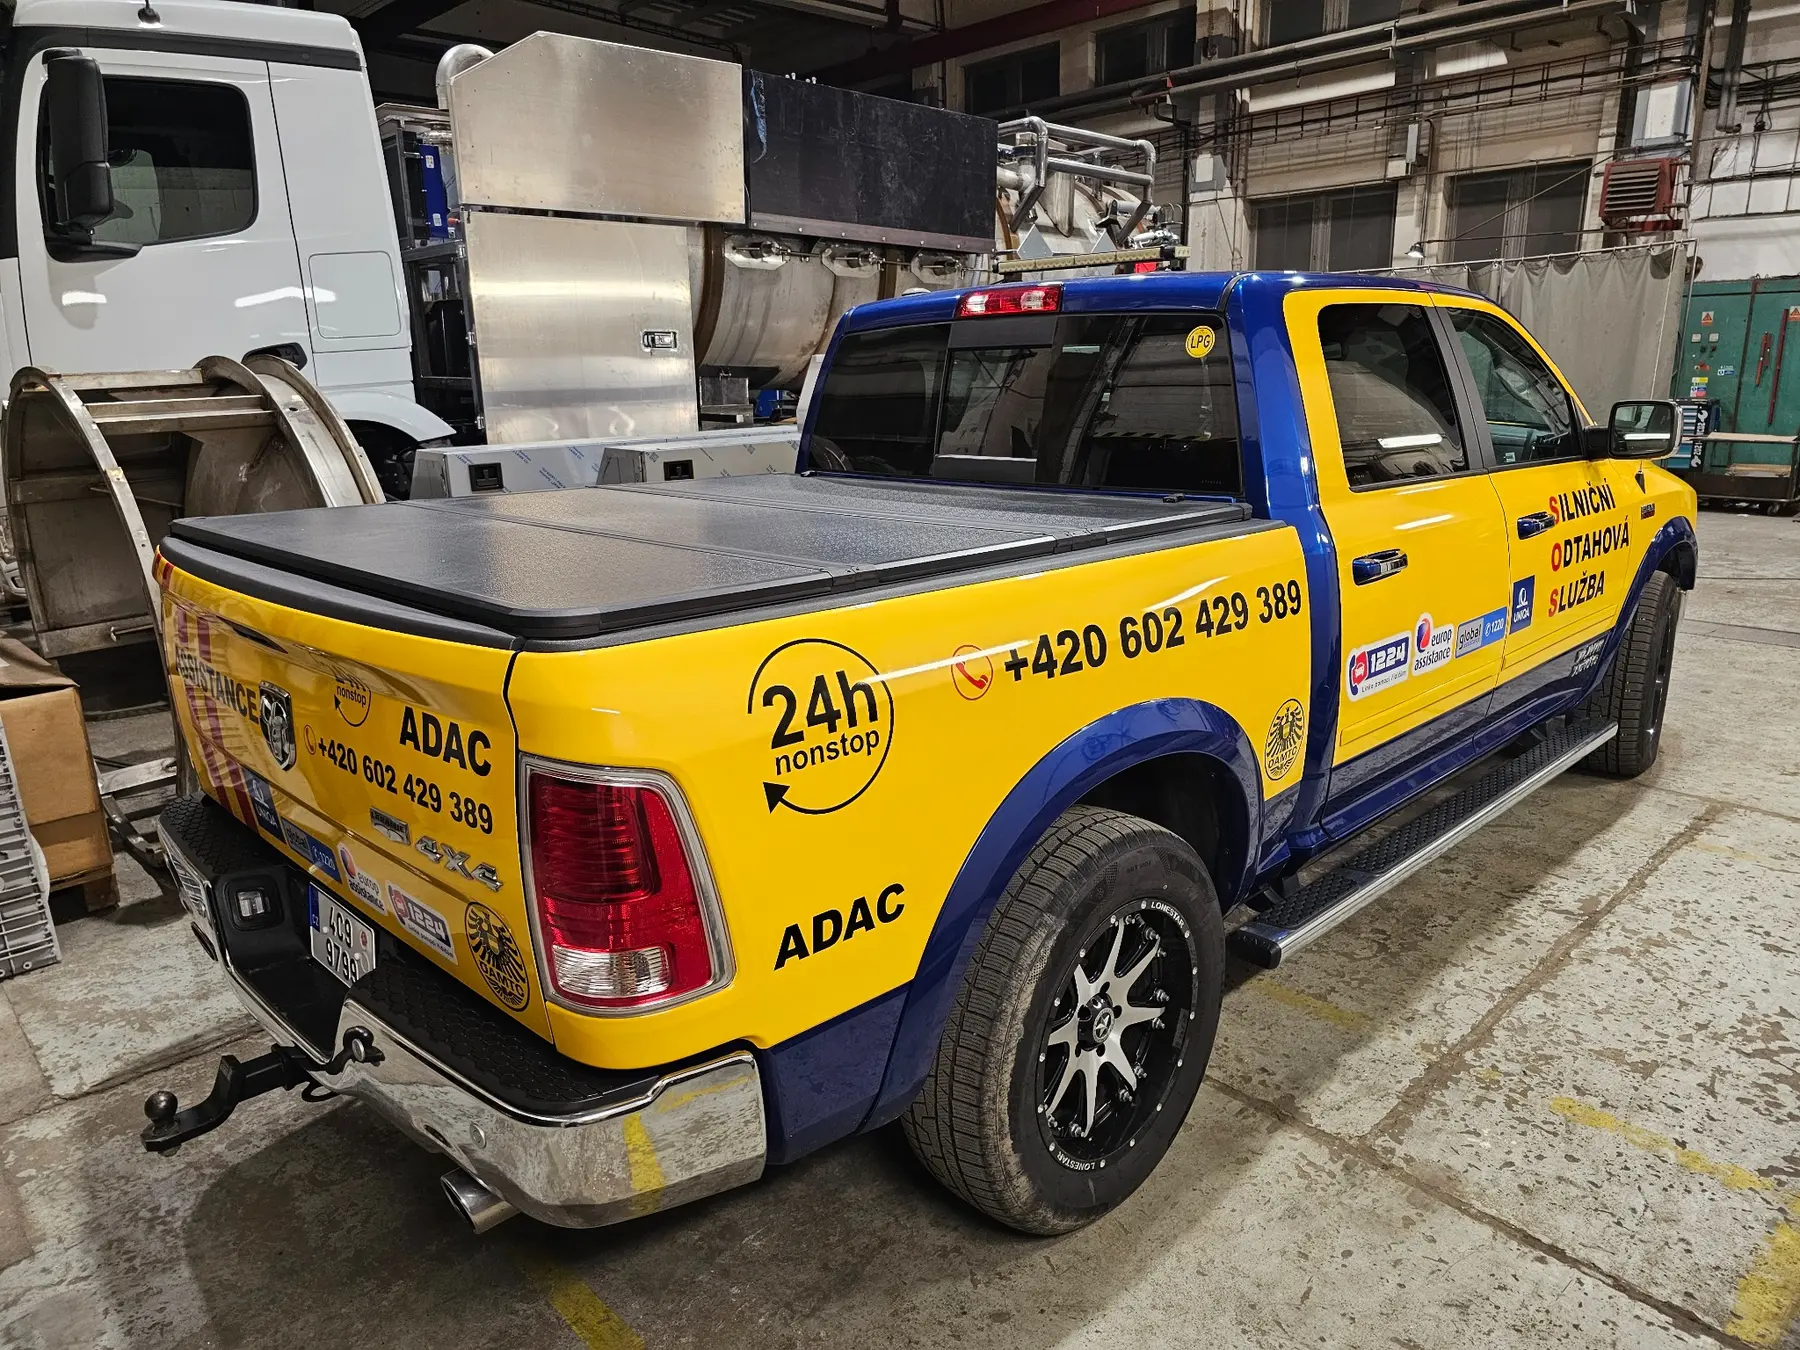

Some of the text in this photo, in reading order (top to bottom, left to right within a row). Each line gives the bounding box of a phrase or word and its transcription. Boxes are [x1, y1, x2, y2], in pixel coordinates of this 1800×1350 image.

[1191, 334, 1211, 349] LPG
[1549, 477, 1616, 525] SILNIČNÍ
[1551, 515, 1630, 572] ODTAHOVÁ
[1548, 570, 1605, 618] SLUŽBA
[1004, 579, 1302, 682] +420 602 429 389
[1458, 618, 1505, 650] global 1220
[1513, 607, 1530, 623] UNIQA
[1370, 642, 1406, 673] 1224
[1431, 628, 1453, 647] europ
[1414, 646, 1450, 671] assistance
[336, 685, 367, 708] nonstop
[762, 670, 878, 749] 24h
[399, 706, 492, 777] ADAC
[775, 730, 880, 776] nonstop
[318, 737, 493, 835] +420 602 429 389
[358, 872, 380, 896] europ
[329, 906, 354, 949] 4C9
[407, 901, 447, 942] 1224
[773, 882, 906, 971] ADAC
[1151, 901, 1185, 928] LONESTAR
[1057, 1151, 1096, 1171] LONESTAR
